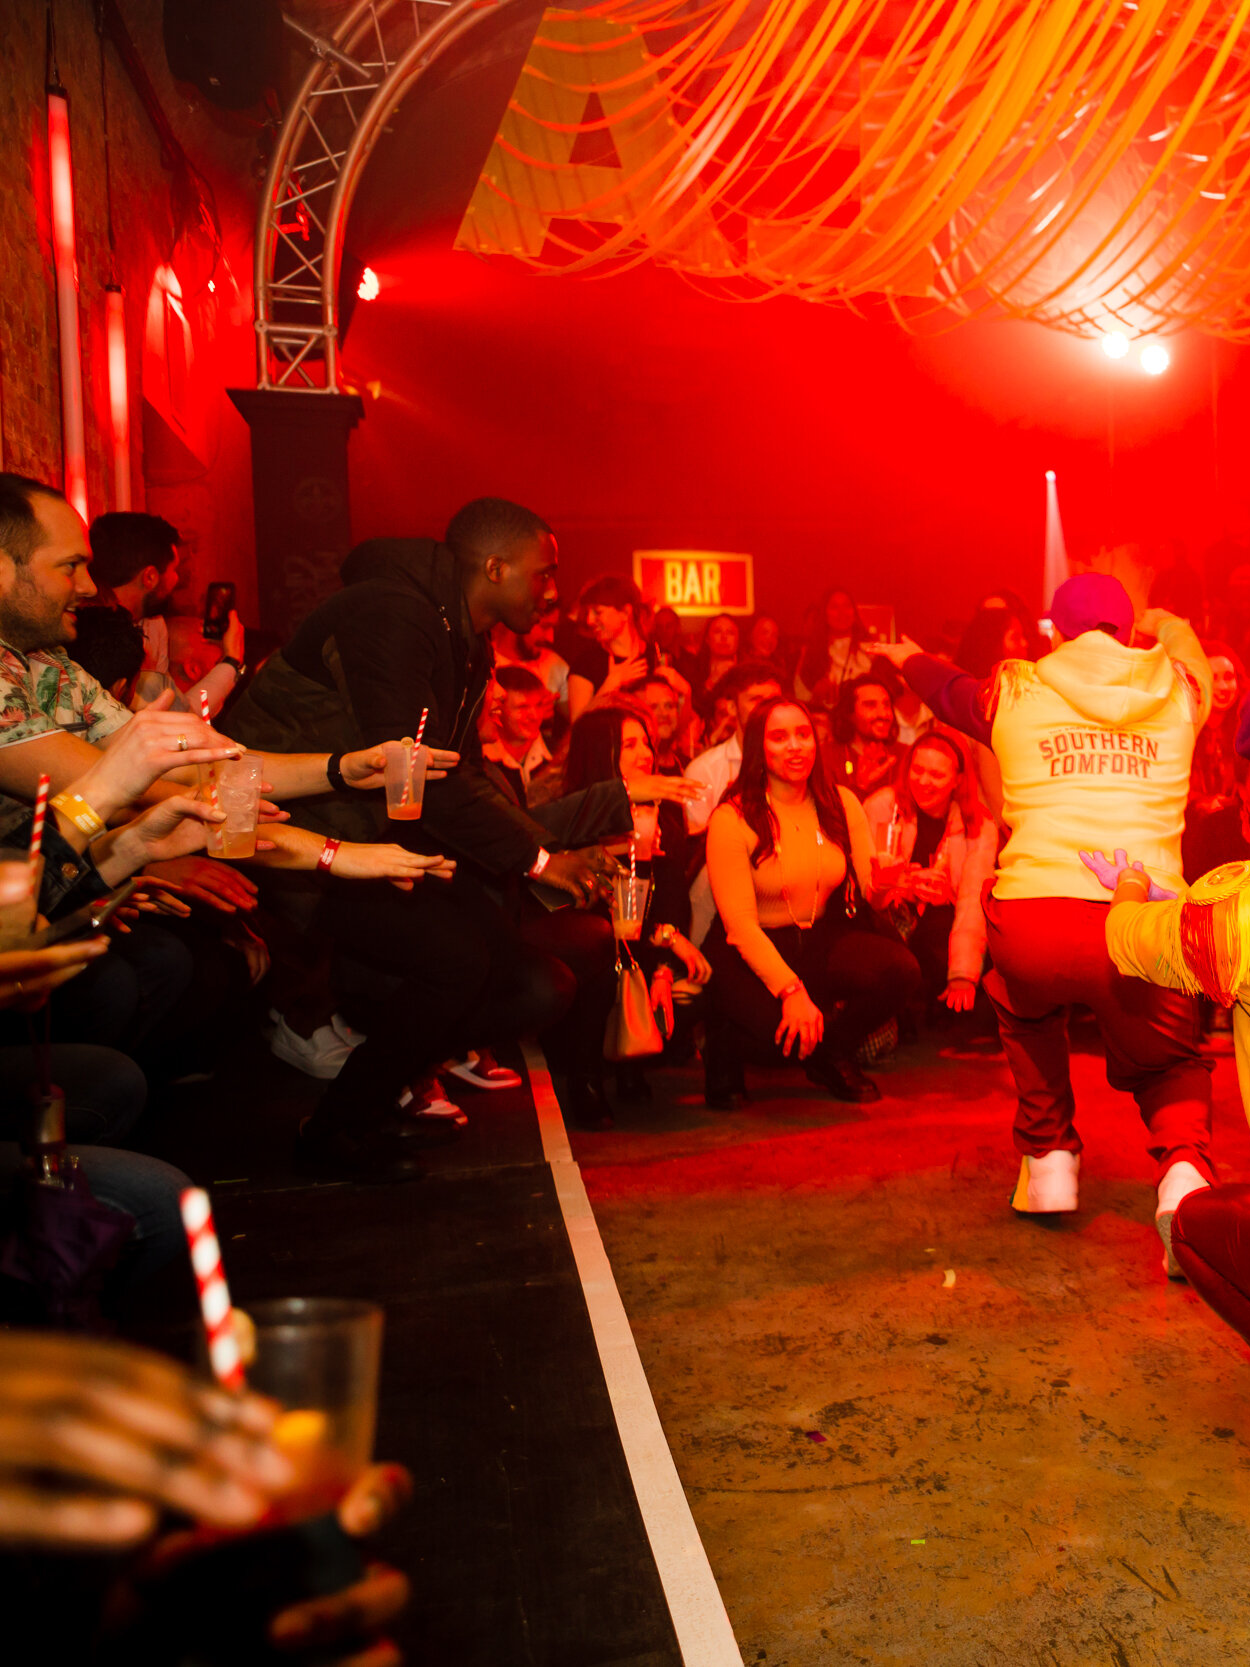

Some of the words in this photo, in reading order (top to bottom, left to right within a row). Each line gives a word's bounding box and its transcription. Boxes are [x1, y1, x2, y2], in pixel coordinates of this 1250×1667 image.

[665, 561, 721, 604] BAR
[1039, 731, 1158, 761] SOUTHERN
[1050, 753, 1151, 779] COMFORT
